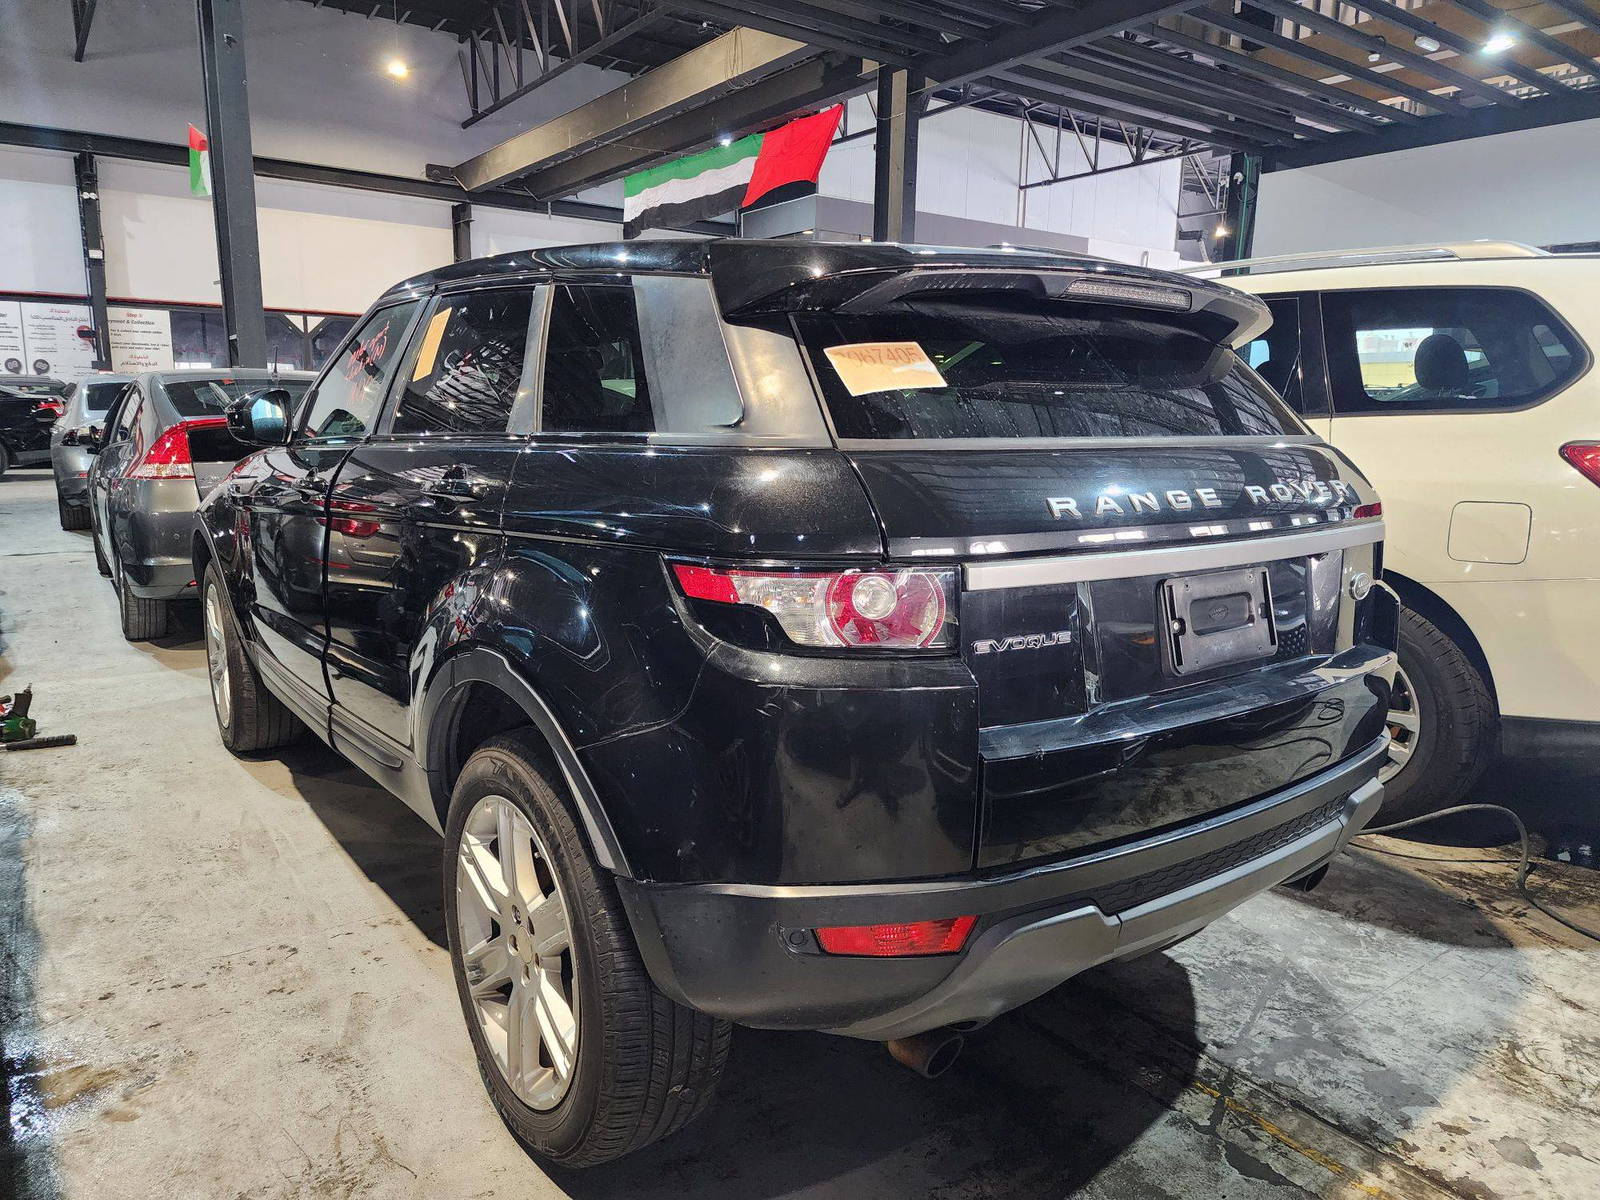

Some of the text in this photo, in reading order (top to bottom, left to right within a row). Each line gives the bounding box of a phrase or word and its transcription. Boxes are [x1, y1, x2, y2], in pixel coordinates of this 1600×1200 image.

[1046, 480, 1350, 520] RANGE ROVER
[971, 630, 1072, 655] EVOQUE
